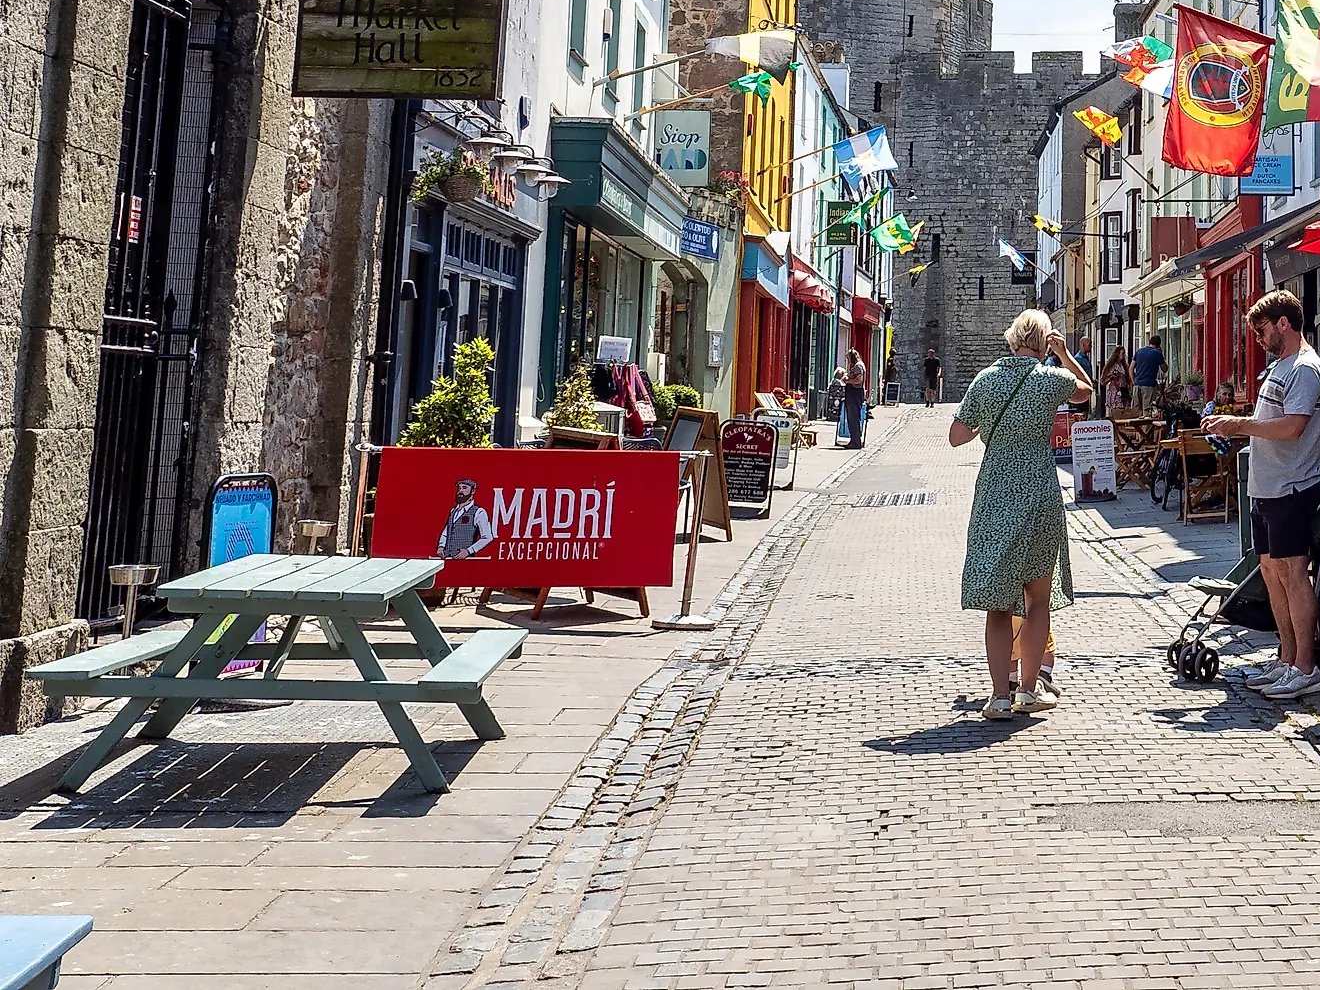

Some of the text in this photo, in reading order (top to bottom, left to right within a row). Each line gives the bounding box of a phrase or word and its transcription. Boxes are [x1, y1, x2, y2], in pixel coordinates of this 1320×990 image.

[353, 32, 425, 65] Hall
[660, 123, 701, 148] Siop
[692, 233, 707, 245] OLIVE
[724, 425, 772, 442] CLEOPATRA'S
[1073, 424, 1112, 435] smoothies
[242, 492, 271, 502] FARCHNAD
[492, 480, 616, 538] MADRÍ
[498, 541, 599, 560] EXCEPCIONAL
